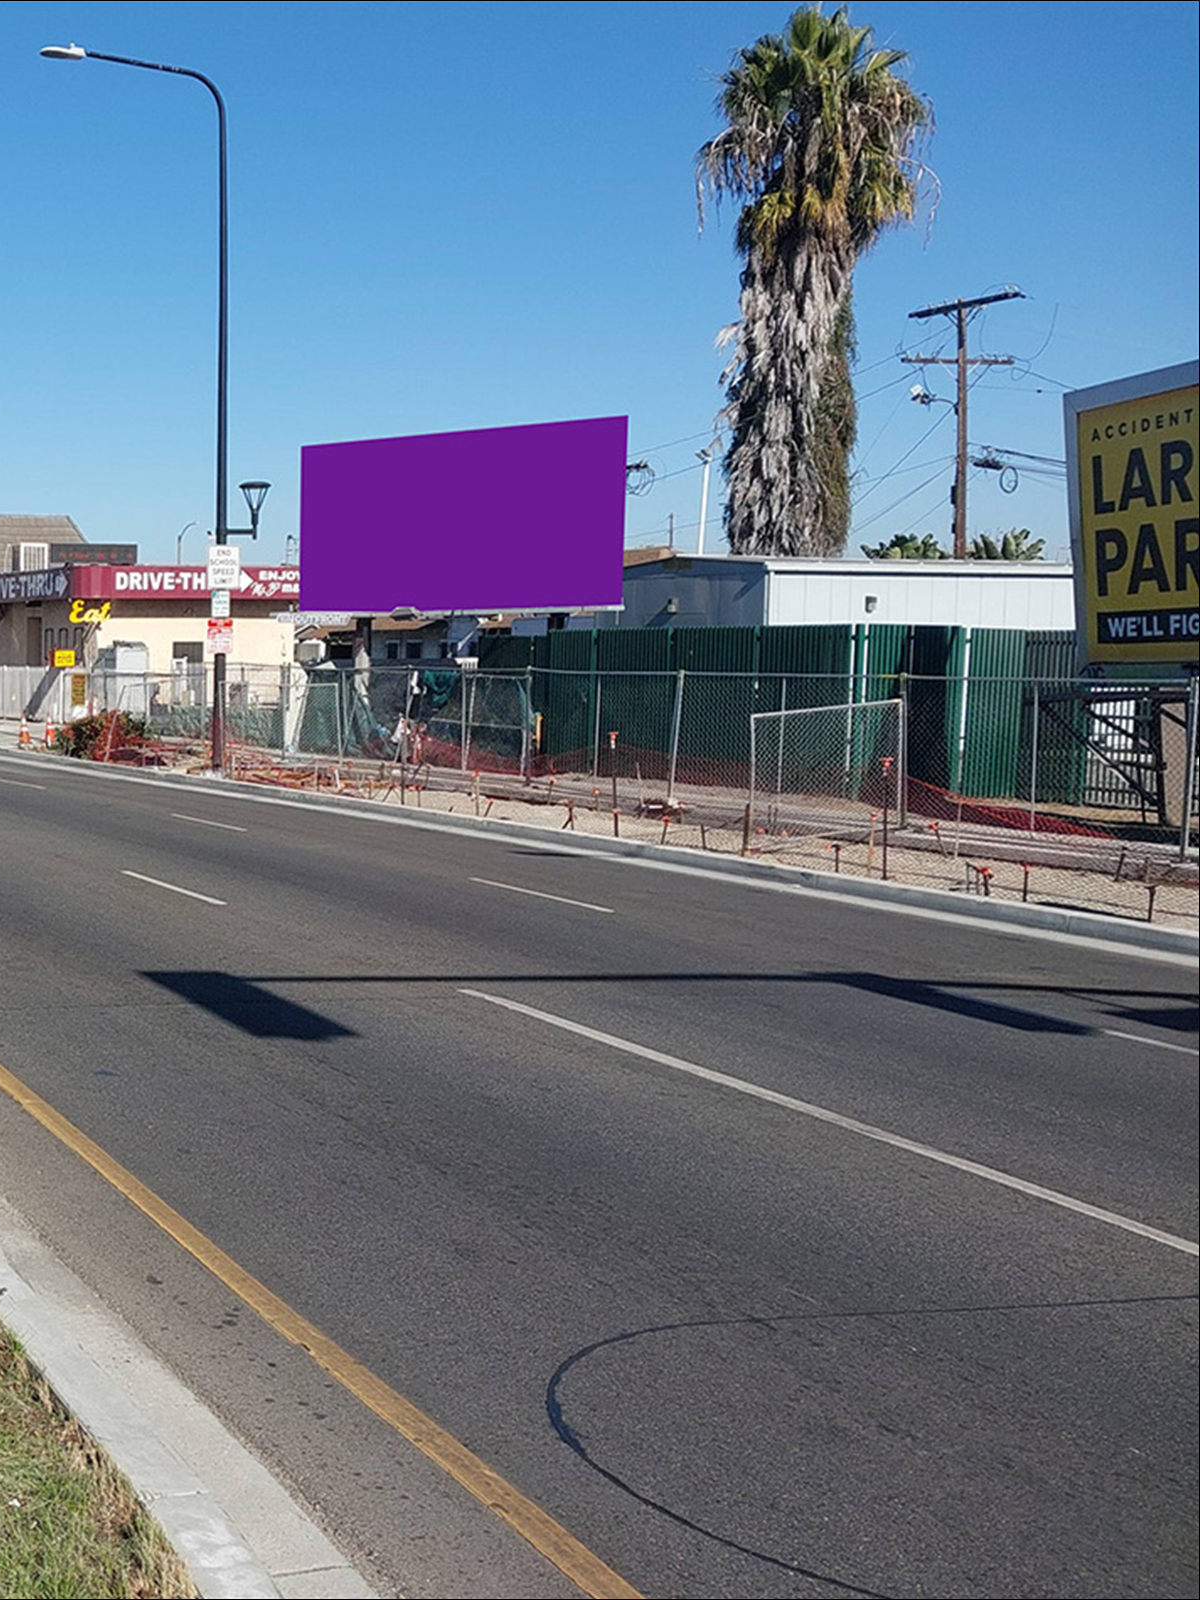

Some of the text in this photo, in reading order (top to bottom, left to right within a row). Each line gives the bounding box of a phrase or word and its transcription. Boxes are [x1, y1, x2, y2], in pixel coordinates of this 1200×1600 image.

[1091, 408, 1194, 442] ACCIDENT
[210, 558, 237, 566] SCHOOL
[1094, 517, 1199, 597] PAR
[115, 571, 206, 591] DRIVE-TH
[212, 567, 235, 576] SPEED
[214, 577, 233, 585] LIMIT
[69, 599, 112, 624] Eat
[1107, 616, 1163, 638] WE'LL
